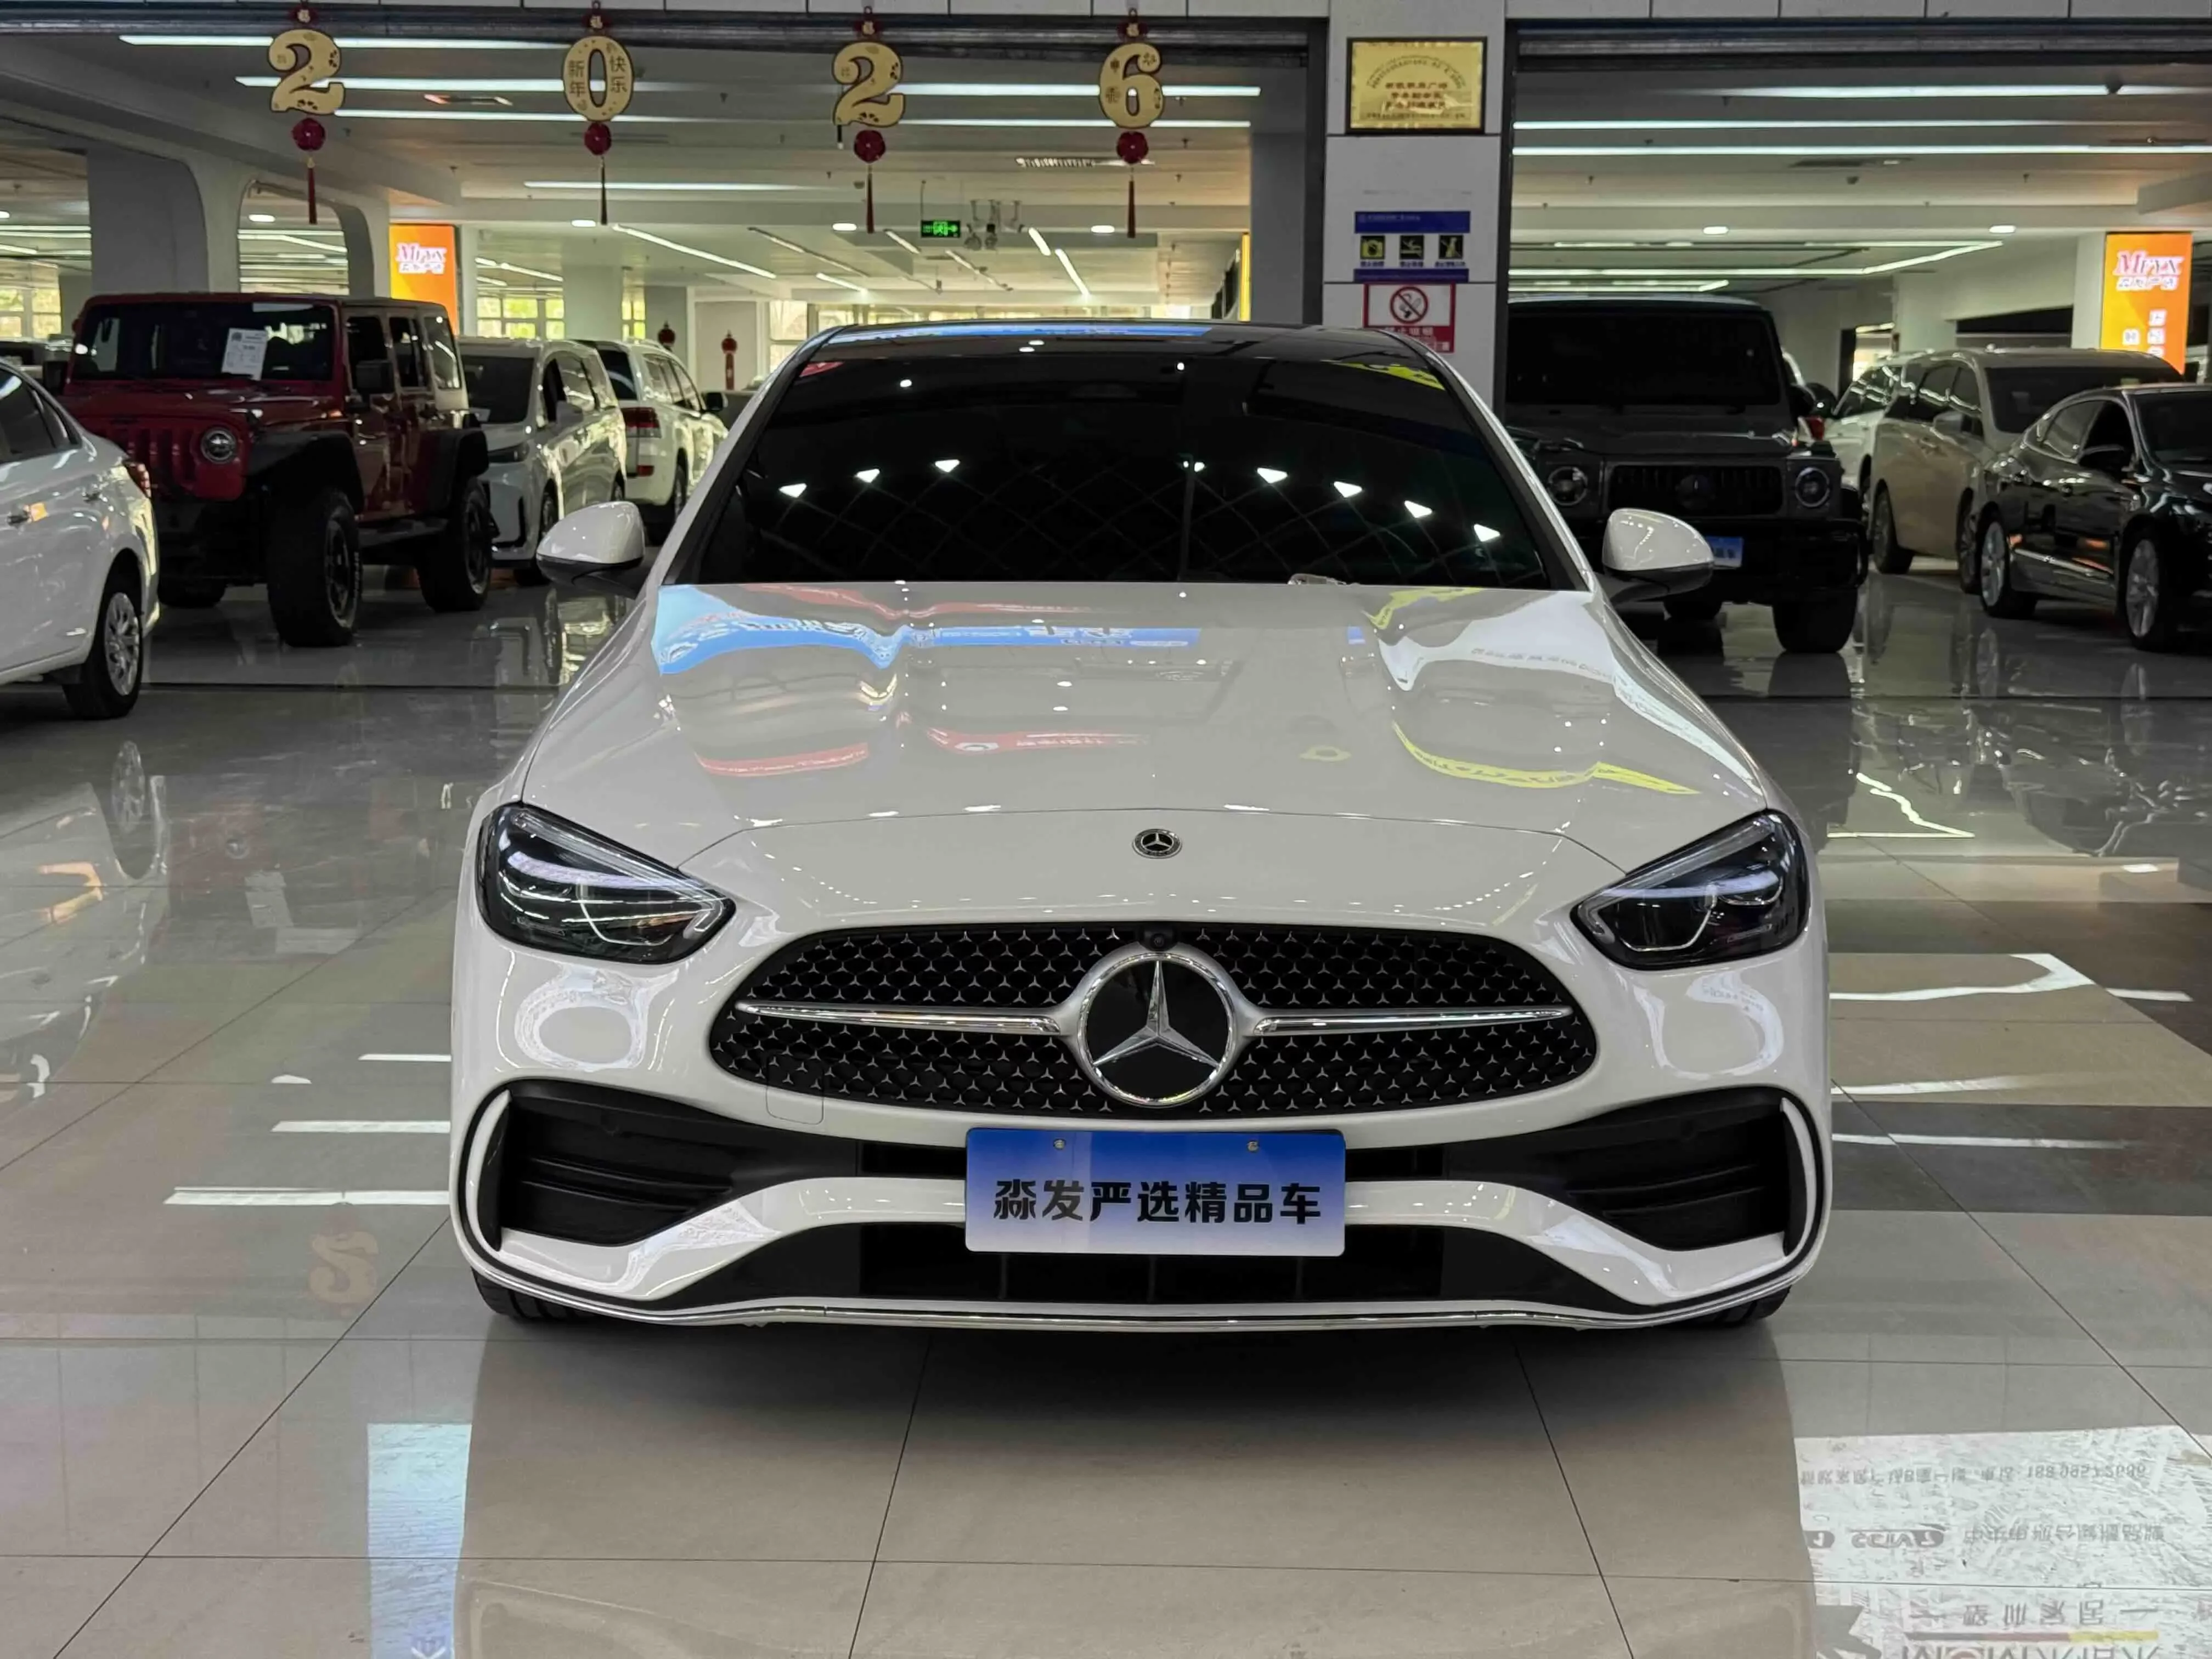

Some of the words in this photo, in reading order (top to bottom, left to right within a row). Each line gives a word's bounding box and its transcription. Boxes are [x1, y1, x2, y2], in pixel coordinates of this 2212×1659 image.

[268, 28, 346, 116] 2
[562, 35, 634, 122] 0
[833, 42, 906, 128] 2
[1099, 42, 1164, 129] 6
[568, 60, 586, 97] 新年
[610, 55, 628, 93] 快乐
[993, 1178, 1322, 1225] 淼发严选精品车
